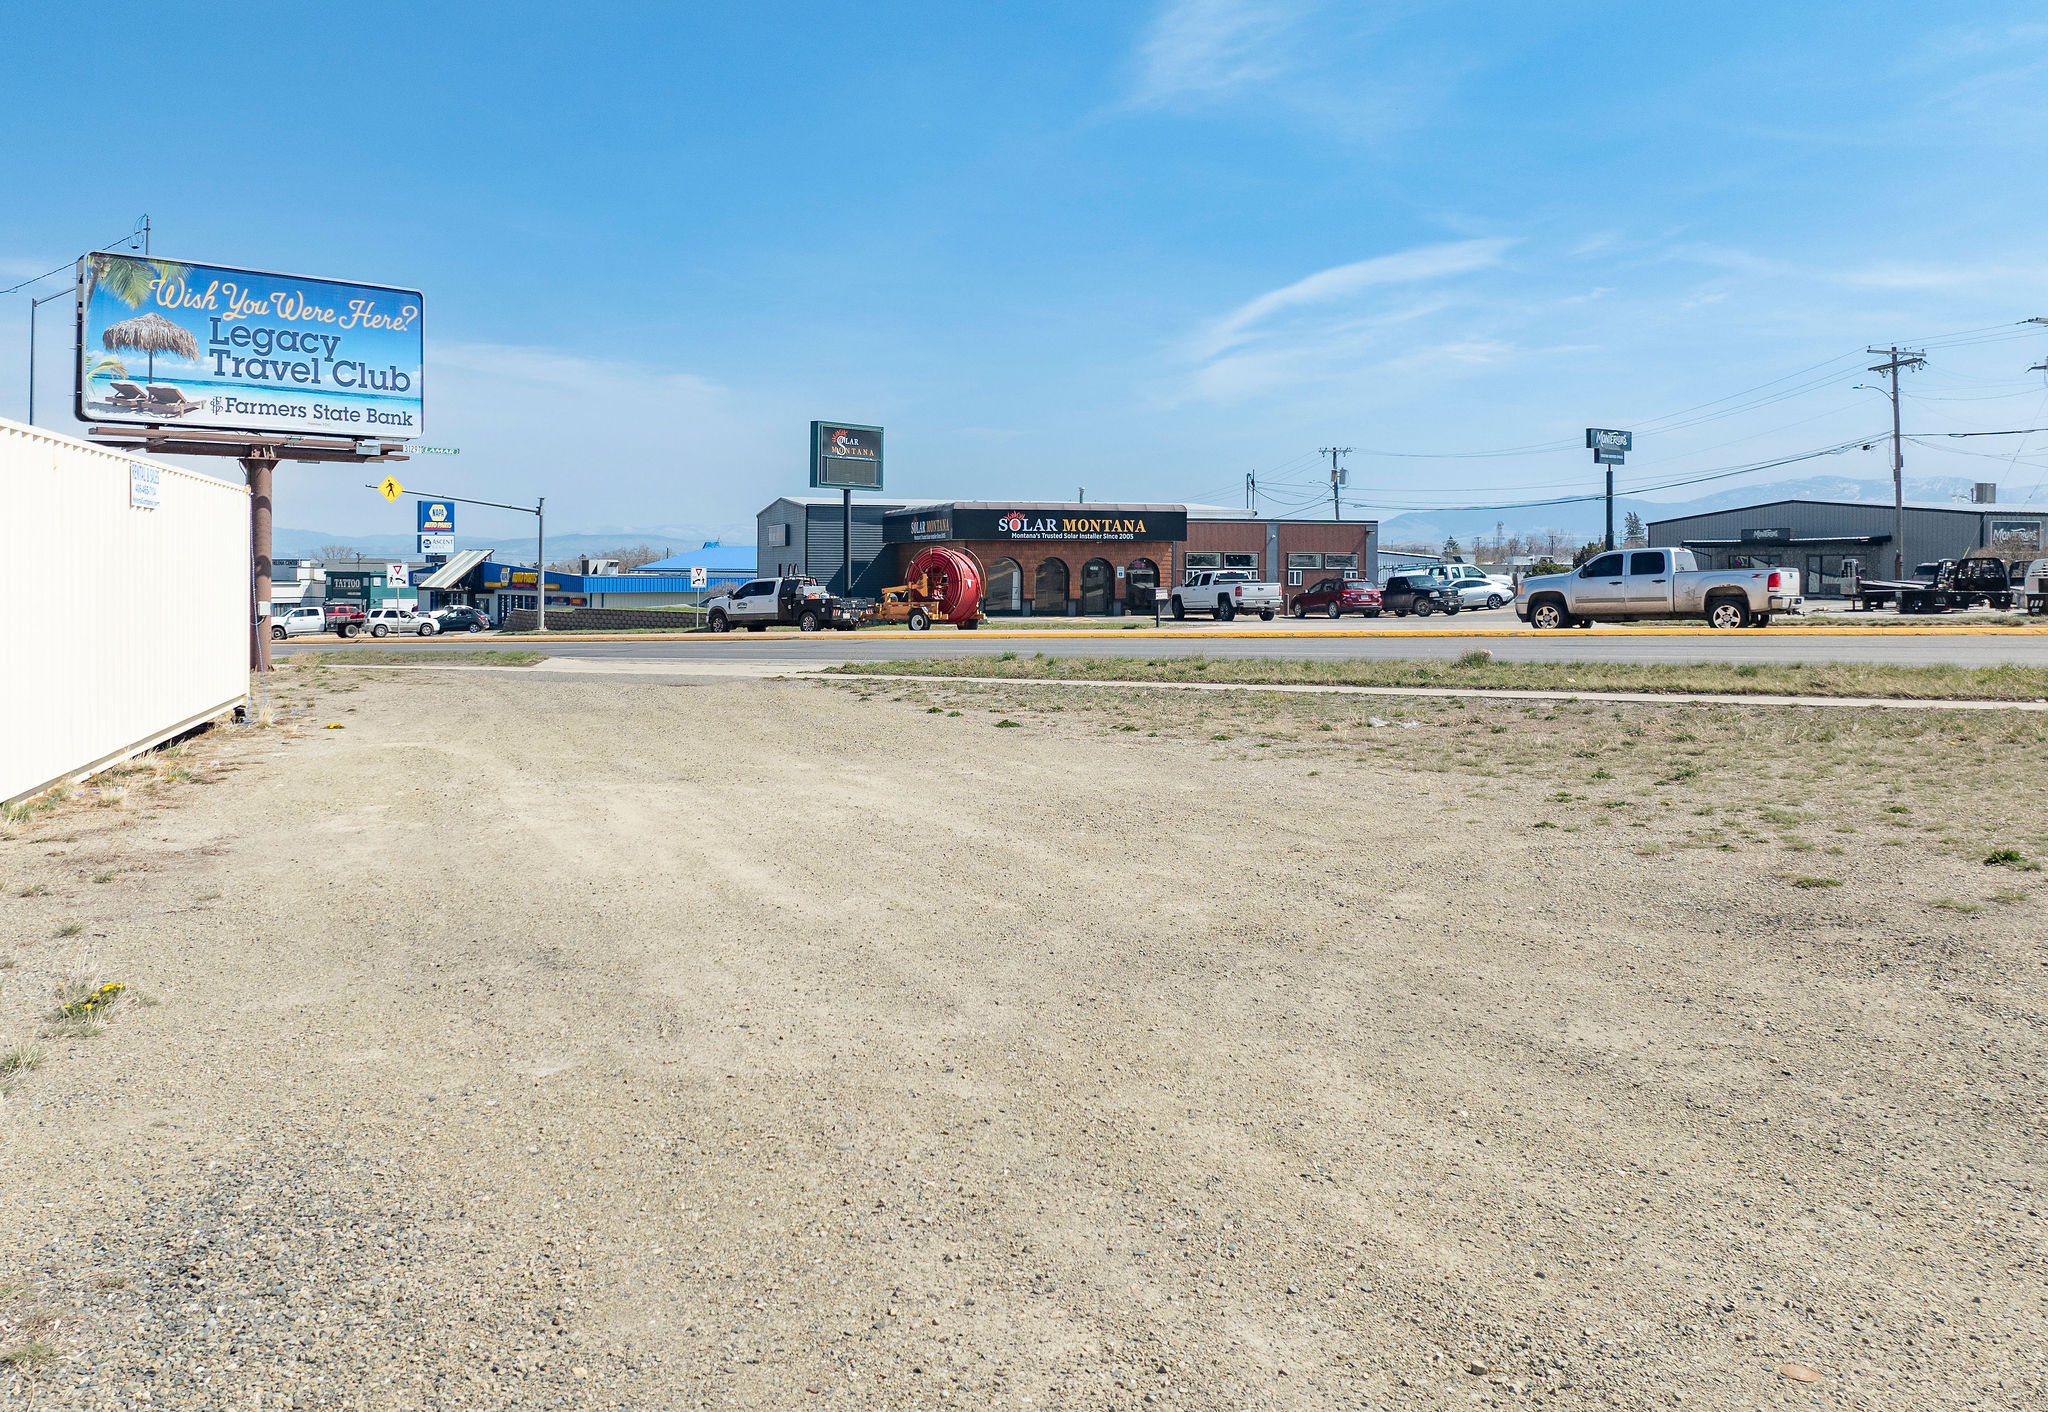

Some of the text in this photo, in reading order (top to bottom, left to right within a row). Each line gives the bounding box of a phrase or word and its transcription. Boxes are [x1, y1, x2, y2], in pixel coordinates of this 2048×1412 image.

[150, 278, 418, 332] Wish You Were Here?
[208, 316, 341, 363] Legacy
[208, 347, 411, 392] Travel Club
[225, 397, 307, 418] Farmers
[313, 403, 361, 423] State
[366, 407, 413, 427] Bank
[425, 447, 456, 455] LAMAR
[832, 446, 874, 457] MONTANA
[432, 508, 444, 517] NAPA
[998, 518, 1147, 533] SOLAR MONTANA
[1079, 532, 1102, 540] Installer
[334, 578, 360, 588] TATTOO
